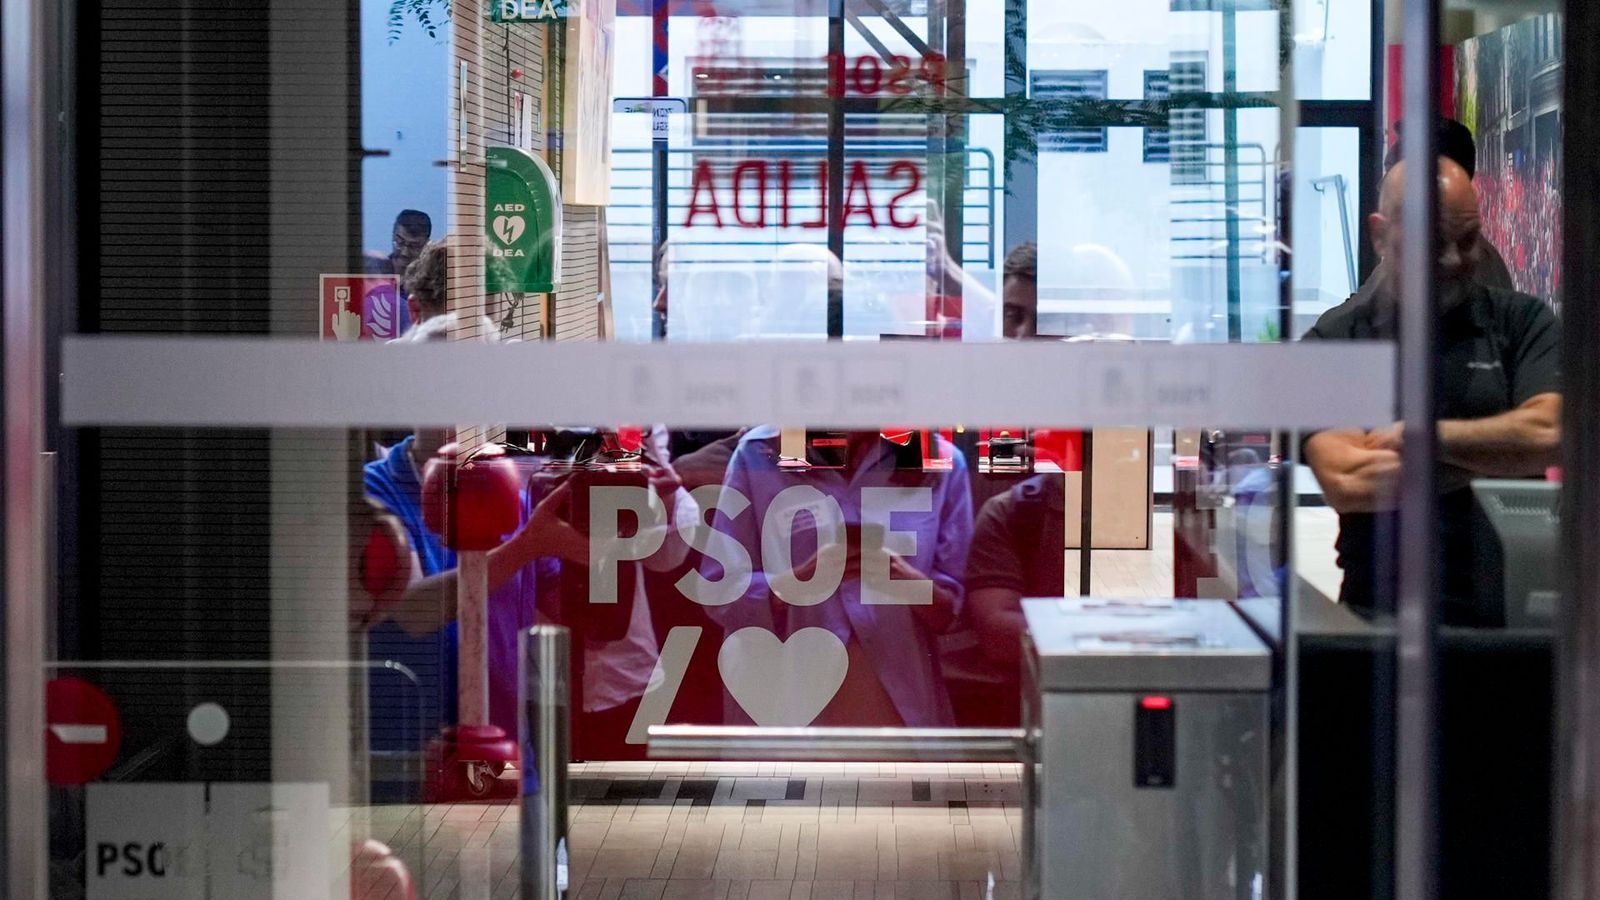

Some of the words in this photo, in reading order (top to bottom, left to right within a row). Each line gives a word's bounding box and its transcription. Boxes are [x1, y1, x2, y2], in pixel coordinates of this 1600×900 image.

[501, 0, 557, 19] DEA
[493, 249, 525, 257] DEA
[588, 484, 934, 607] PSOE
